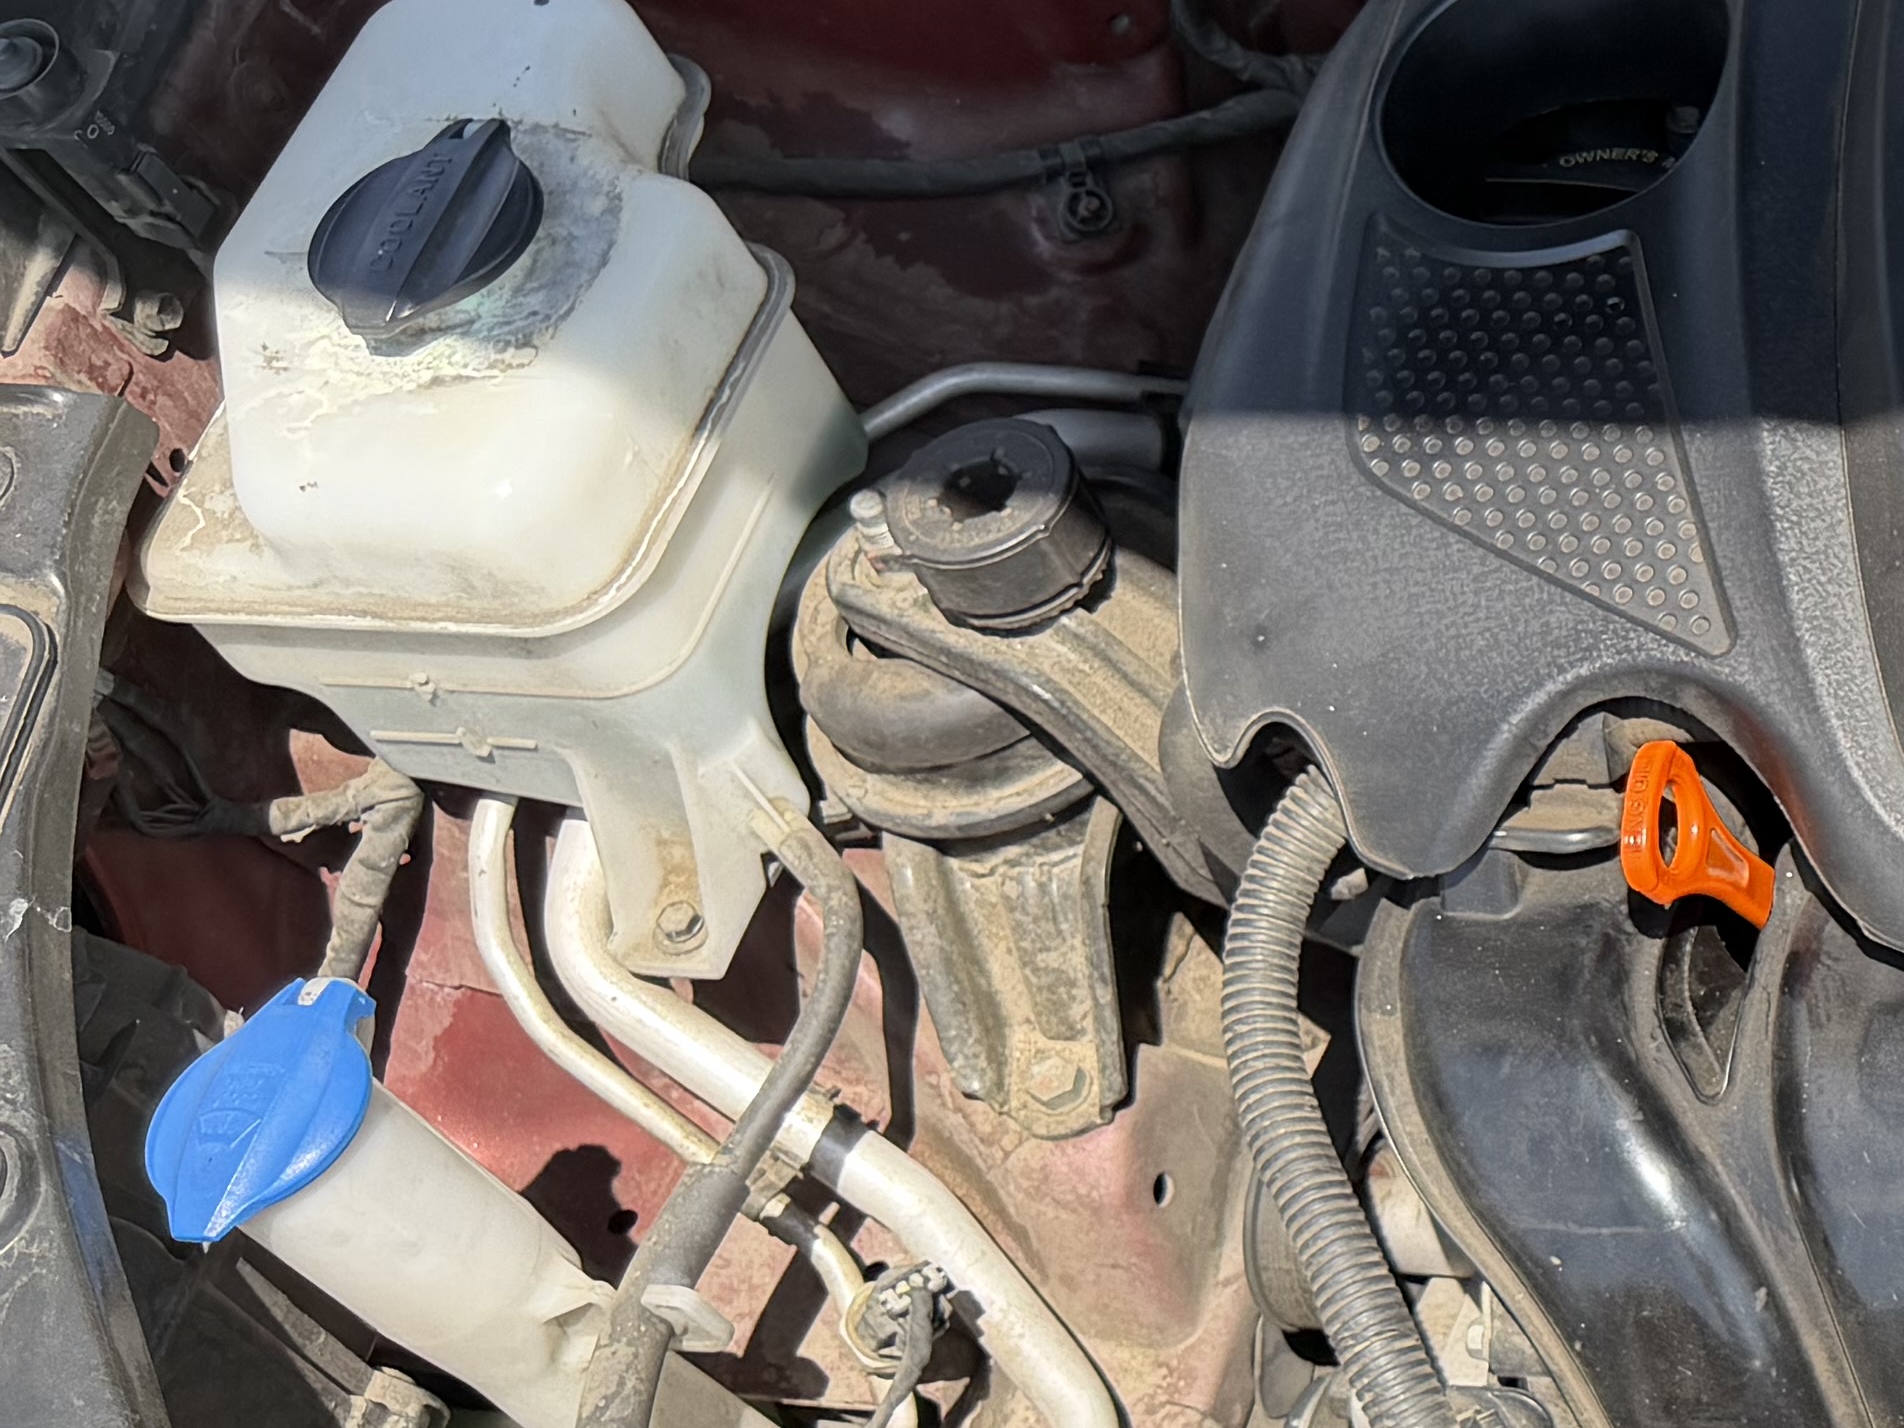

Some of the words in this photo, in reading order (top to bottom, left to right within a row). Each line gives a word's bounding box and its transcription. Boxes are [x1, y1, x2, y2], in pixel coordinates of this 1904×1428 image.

[1559, 147, 1659, 168] OWNER'S
[368, 153, 452, 272] COOLANT
[1631, 763, 1650, 792] OIL
[1622, 798, 1647, 853] ENG
